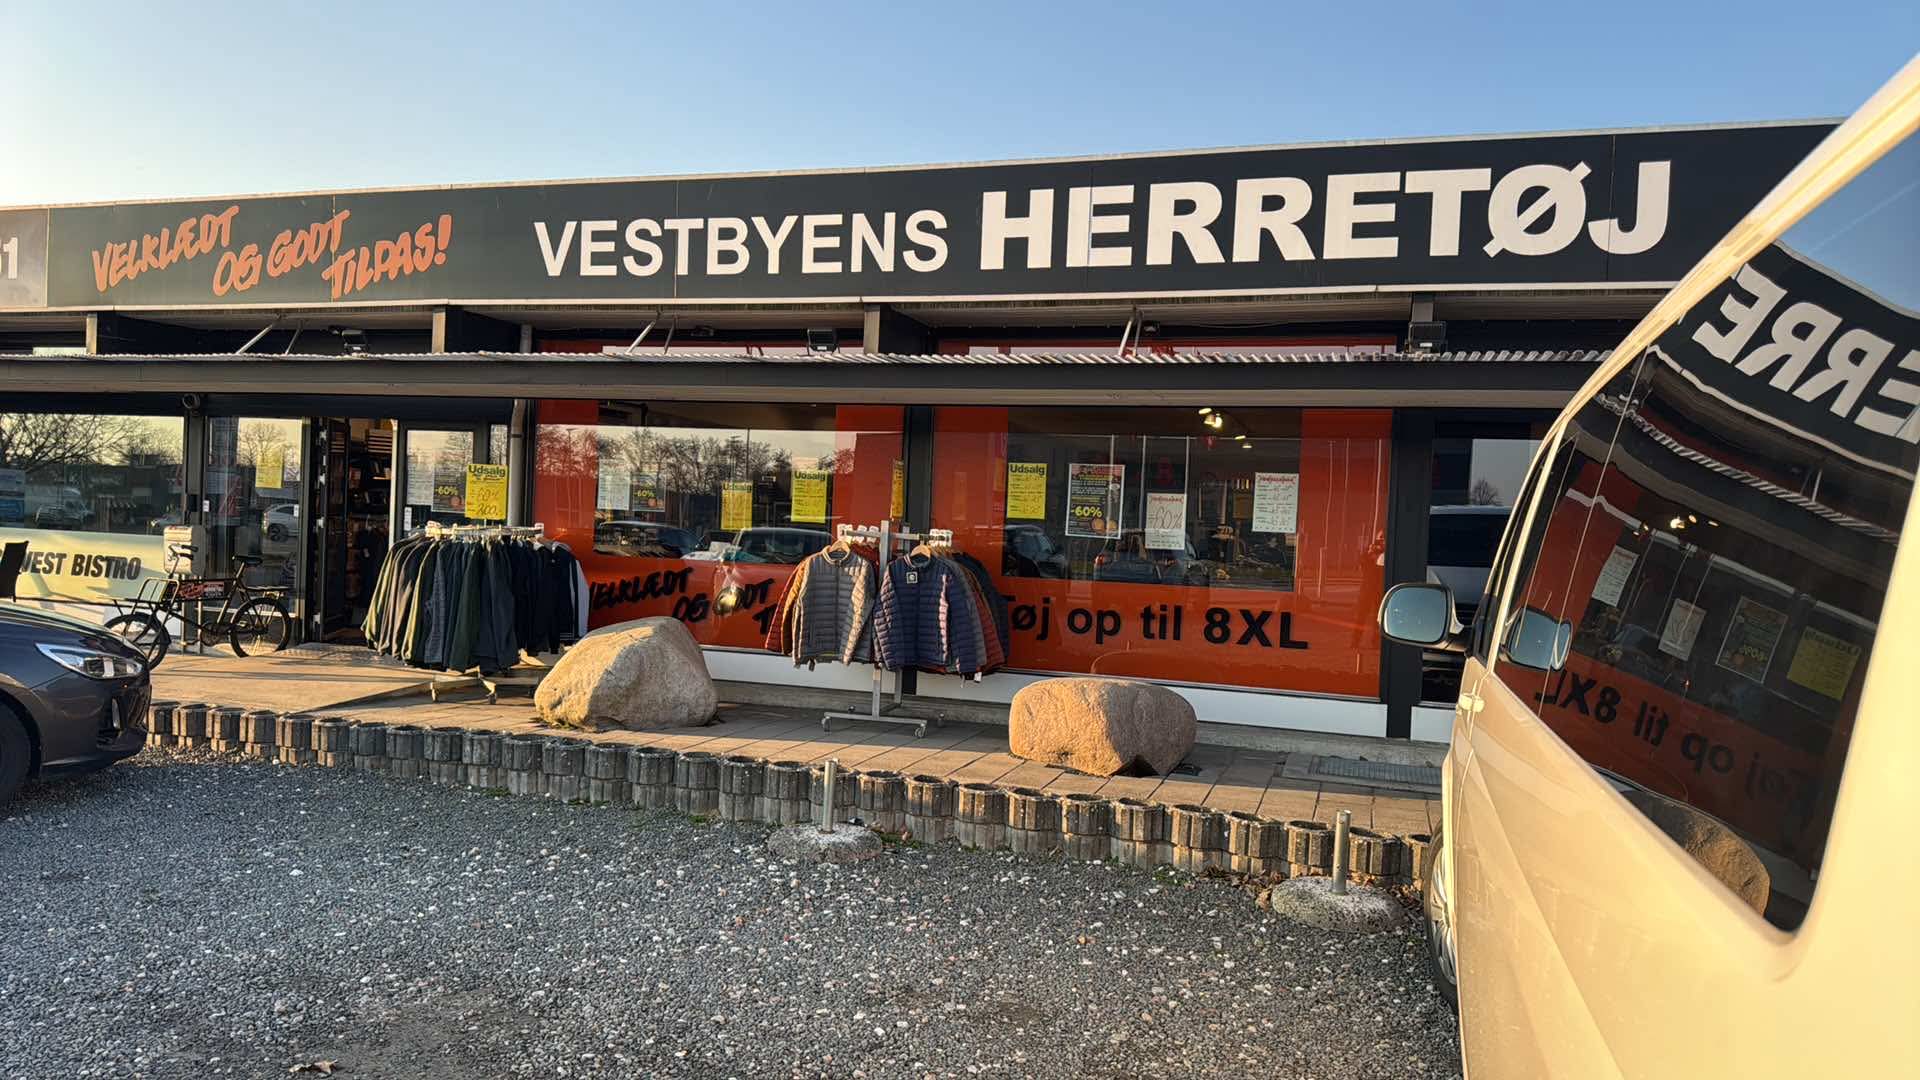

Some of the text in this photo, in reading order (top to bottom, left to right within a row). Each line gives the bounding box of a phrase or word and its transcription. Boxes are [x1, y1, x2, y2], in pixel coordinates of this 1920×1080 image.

[534, 160, 1670, 278] VESTBYENS HERRETØJ
[0, 236, 18, 286] 1
[92, 206, 240, 293] VELKLÆDT
[212, 209, 351, 297] OG GODT
[321, 214, 453, 301] TILPAS!
[468, 464, 505, 477] Udsalg
[794, 471, 826, 481] Udsalg
[1009, 463, 1045, 475] Udsalg
[1071, 505, 1102, 518] -60%
[70, 553, 142, 580] BISTRO
[672, 593, 709, 623] OG
[1066, 606, 1122, 645] op
[1140, 604, 1183, 641] til
[1203, 606, 1310, 650] 8XL
